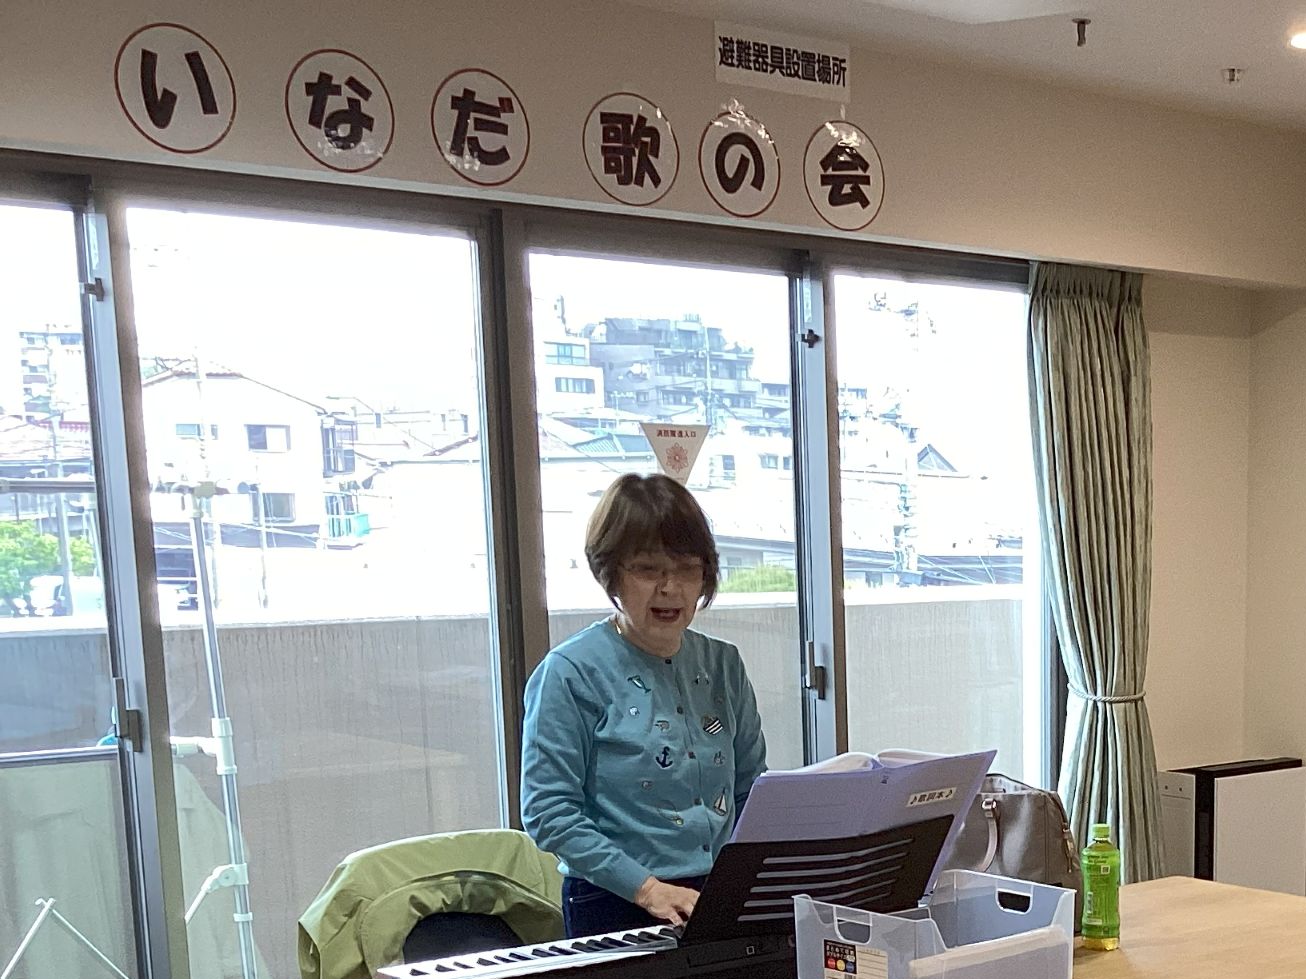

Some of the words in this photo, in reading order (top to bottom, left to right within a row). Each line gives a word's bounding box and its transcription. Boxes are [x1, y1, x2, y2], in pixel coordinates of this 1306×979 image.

[718, 35, 847, 88] 避難器具設置場所
